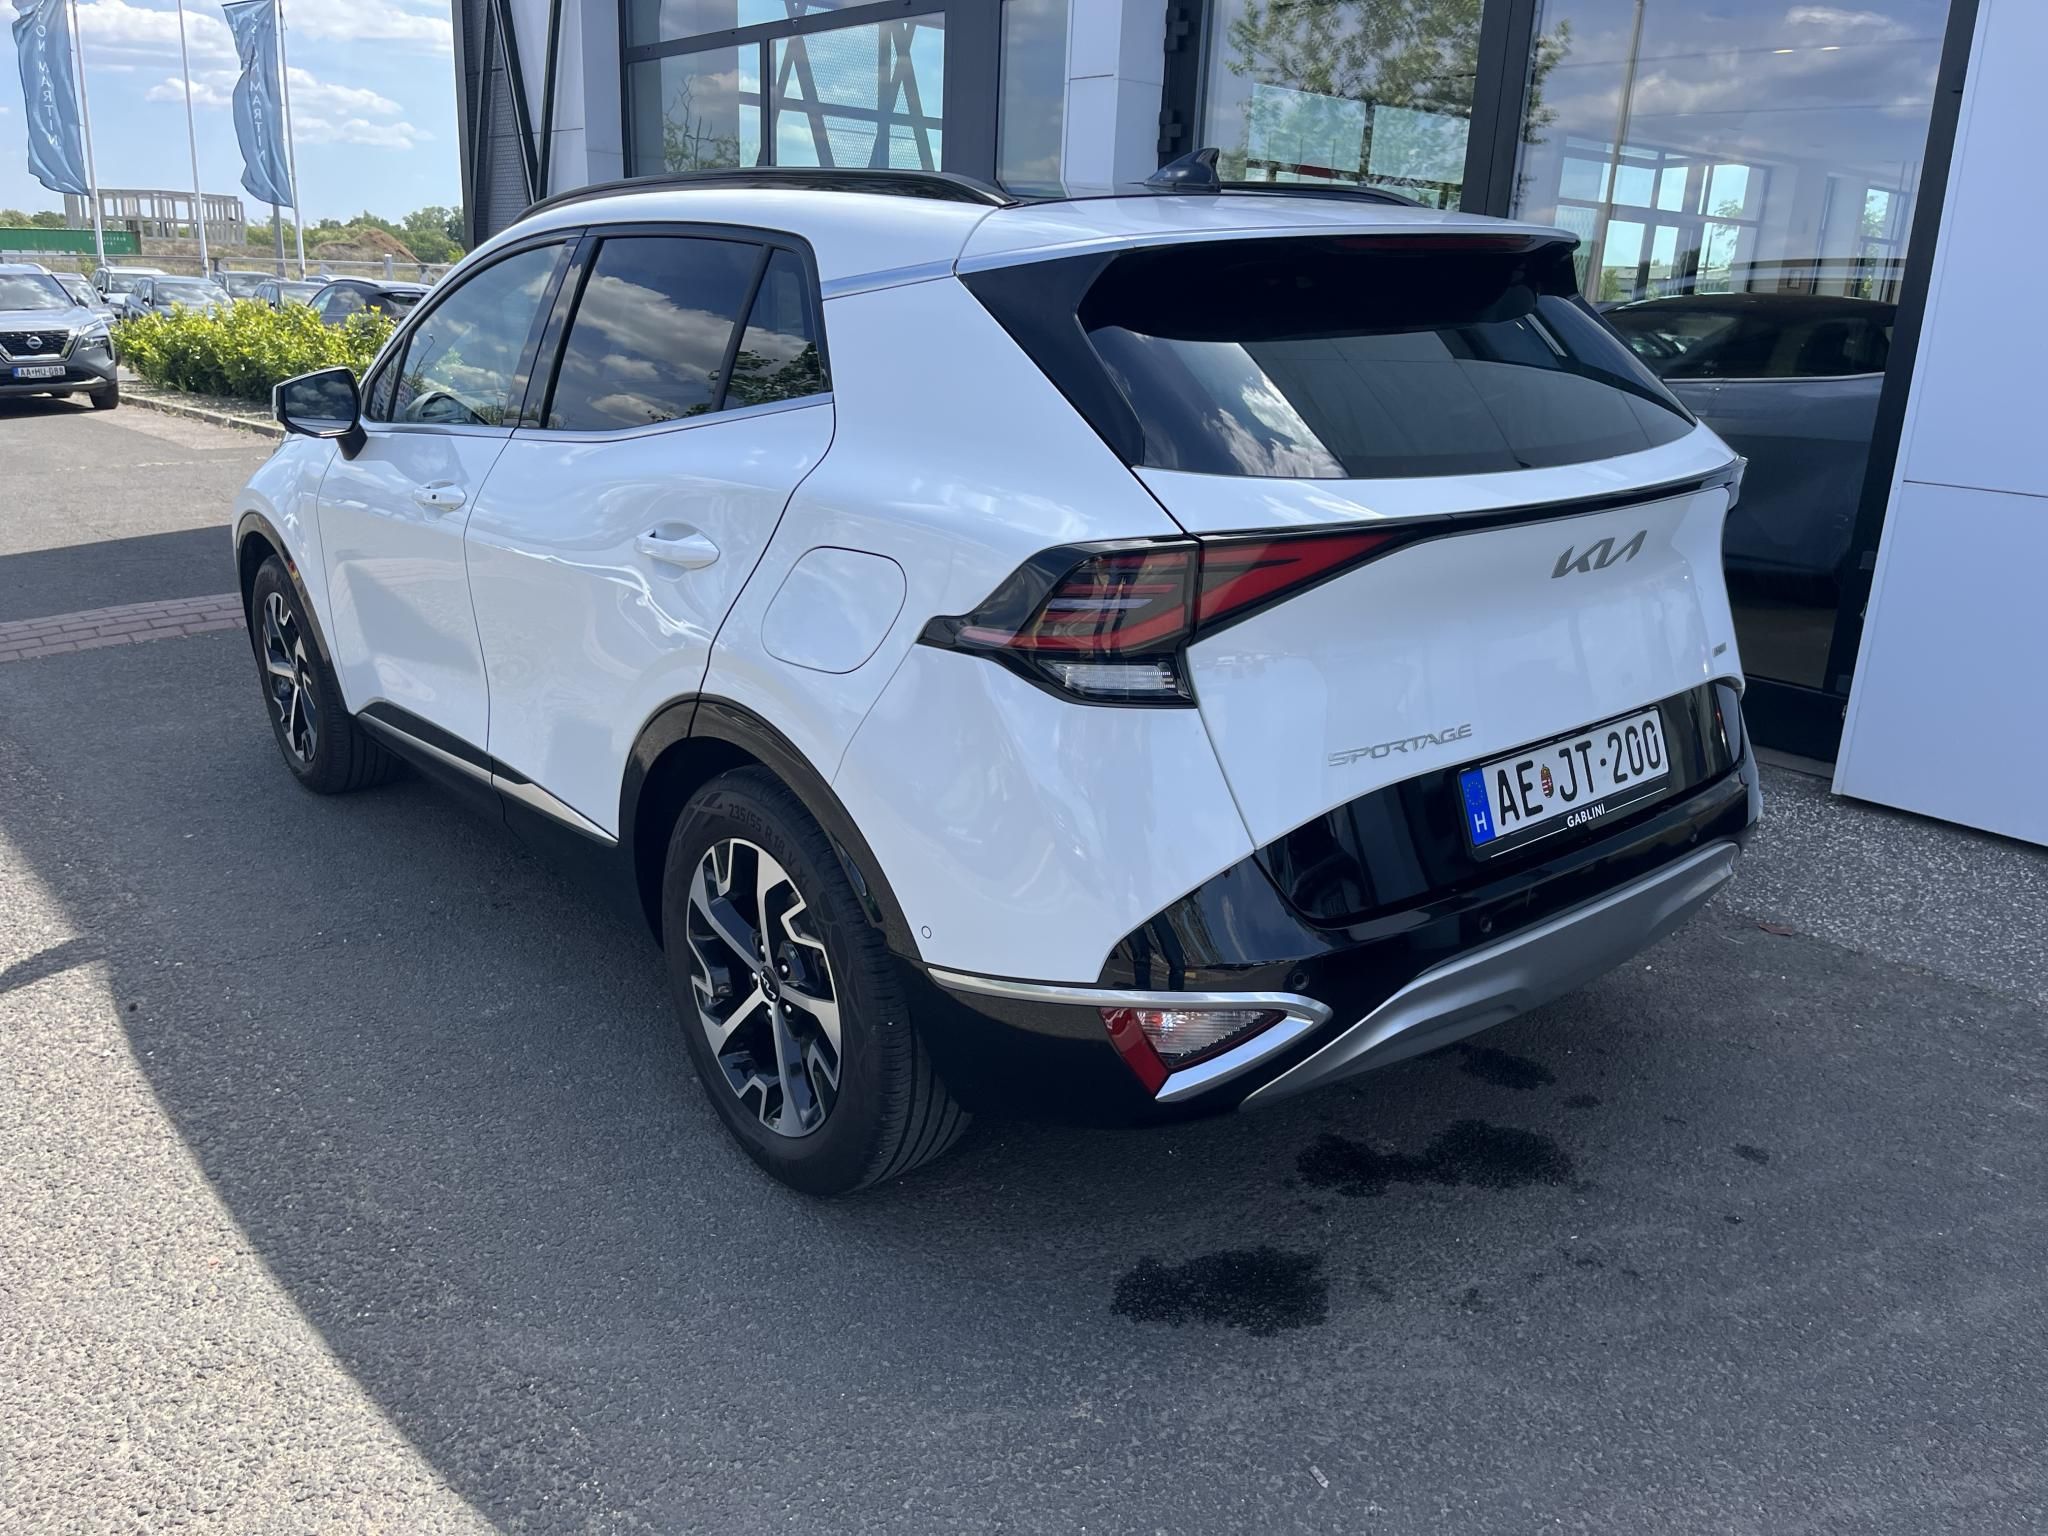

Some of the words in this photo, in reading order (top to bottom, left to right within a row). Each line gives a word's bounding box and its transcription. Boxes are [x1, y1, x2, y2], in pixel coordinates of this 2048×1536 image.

[1551, 529, 1648, 579] KIA
[1327, 723, 1472, 767] SPORTAGE
[728, 803, 762, 833] 235/55
[1473, 811, 1488, 833] H
[1497, 760, 1544, 826] AE
[1566, 803, 1606, 828] GABLINI
